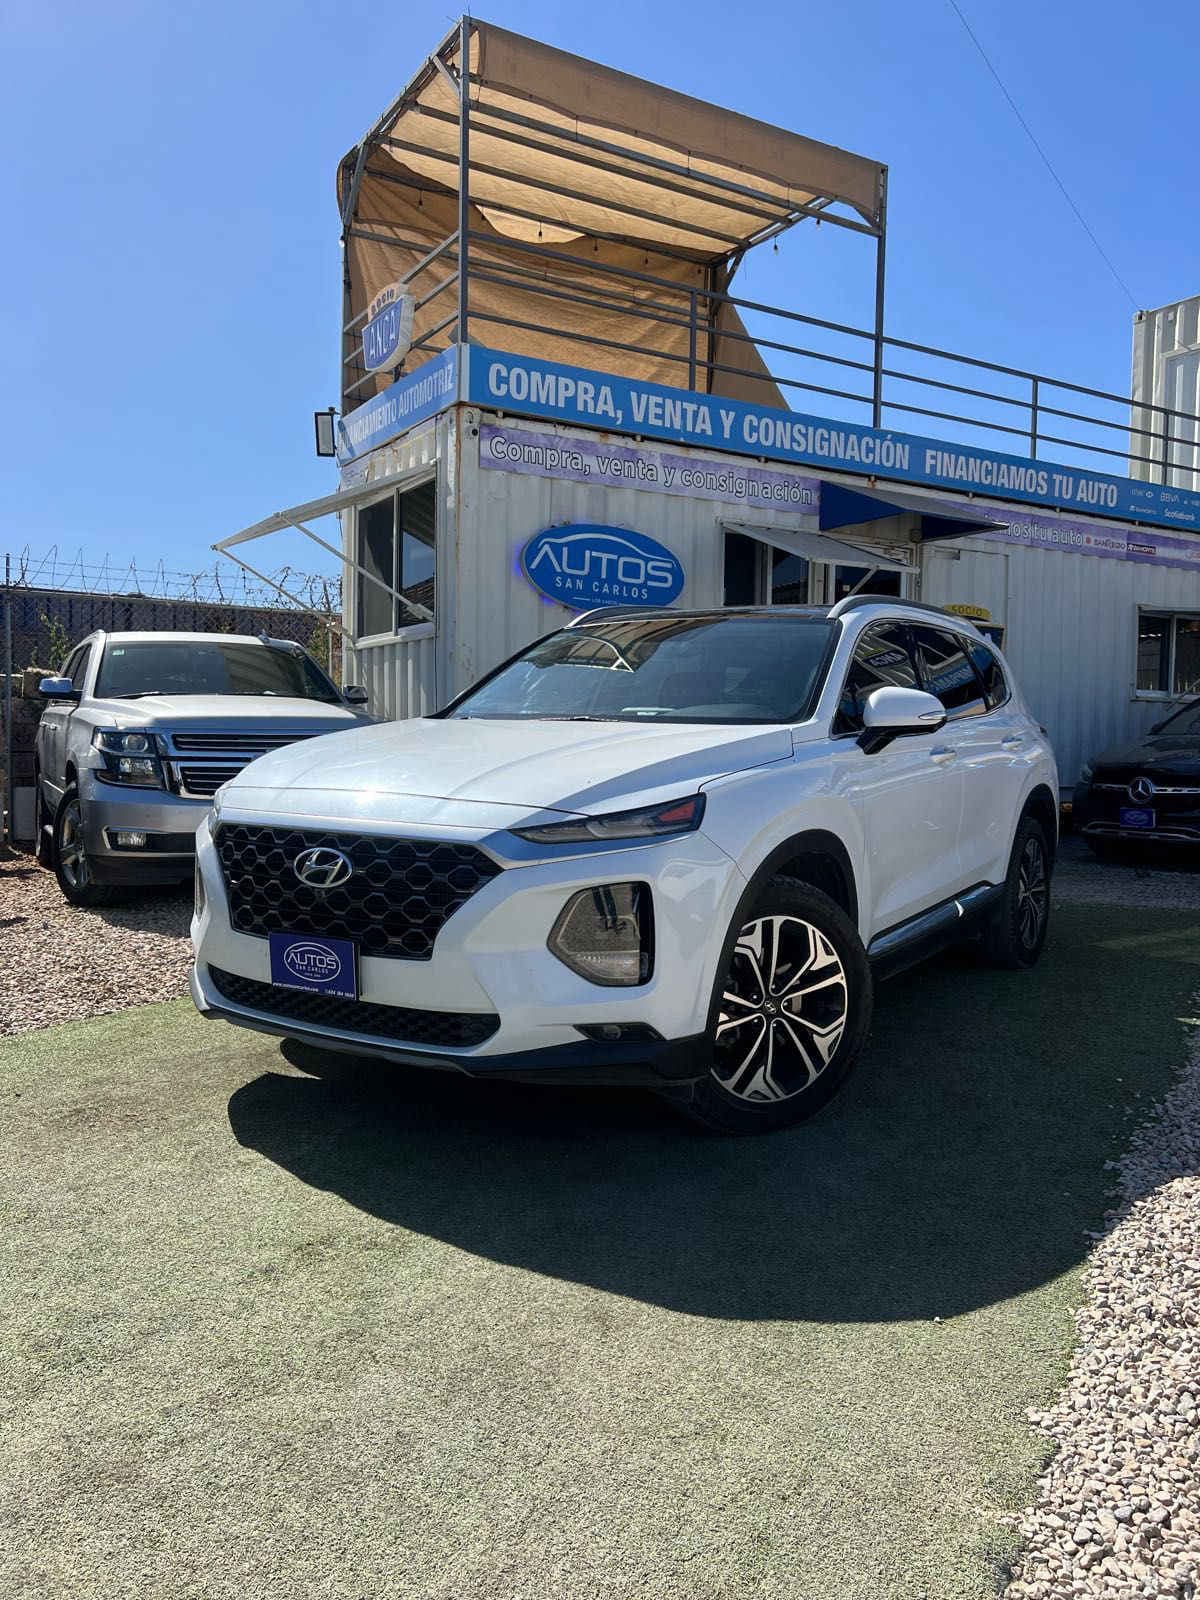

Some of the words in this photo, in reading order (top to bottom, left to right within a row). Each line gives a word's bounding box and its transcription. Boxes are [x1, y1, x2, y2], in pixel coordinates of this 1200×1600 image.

[369, 310, 397, 359] ANCA
[399, 364, 454, 418] AUTOMOTRIZ
[488, 363, 624, 425] COMPRA,
[630, 391, 712, 436] VENTA
[719, 409, 736, 439] Y
[743, 414, 910, 471] CONSIGNACIÓN
[925, 449, 1048, 495] FINANCIAMOS
[1052, 474, 1073, 500] TU
[1076, 479, 1118, 508] AUTO
[489, 436, 591, 475] Compra,
[597, 455, 659, 482] venta
[664, 464, 677, 487] y
[680, 470, 815, 506] consignación
[1033, 522, 1049, 542] tu
[1052, 526, 1084, 546] auto
[529, 544, 674, 589] AUTOS
[555, 576, 584, 590] SAN
[592, 581, 649, 600] CARLOS
[287, 952, 337, 970] AUTOS
